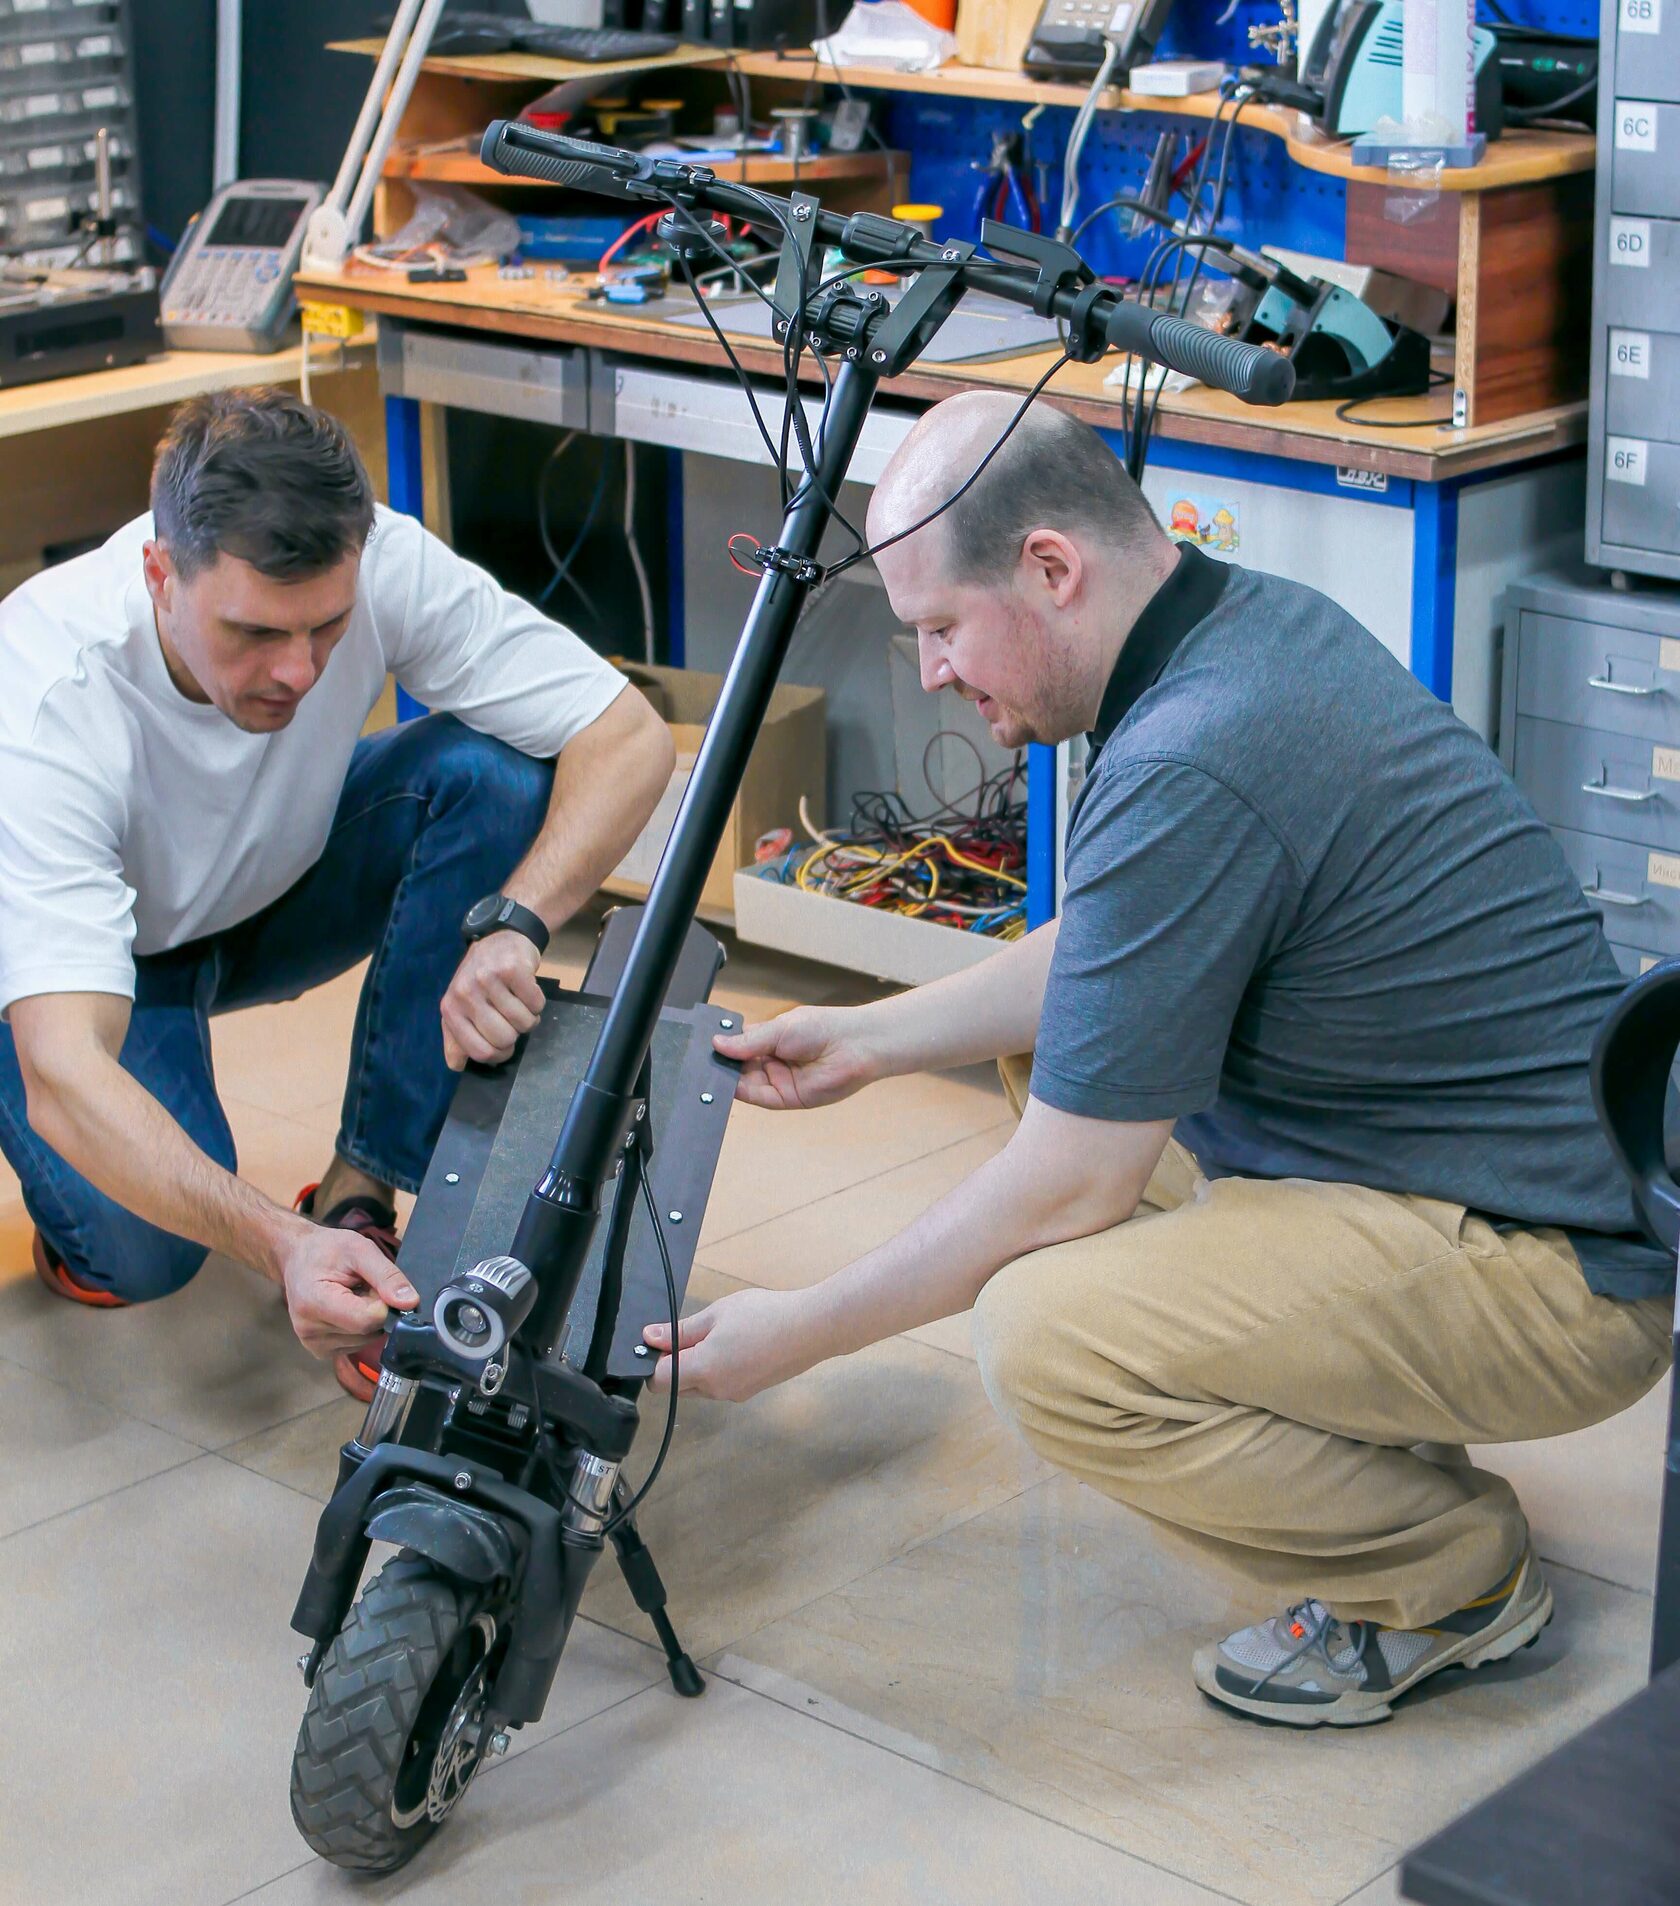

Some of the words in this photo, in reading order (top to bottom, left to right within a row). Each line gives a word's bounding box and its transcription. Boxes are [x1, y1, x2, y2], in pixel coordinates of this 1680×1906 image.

[1627, 0, 1652, 19] 6B
[1623, 117, 1649, 137] 6C
[1617, 233, 1643, 251] 6D
[1617, 345, 1641, 364] 6E
[1614, 451, 1638, 468] 6F
